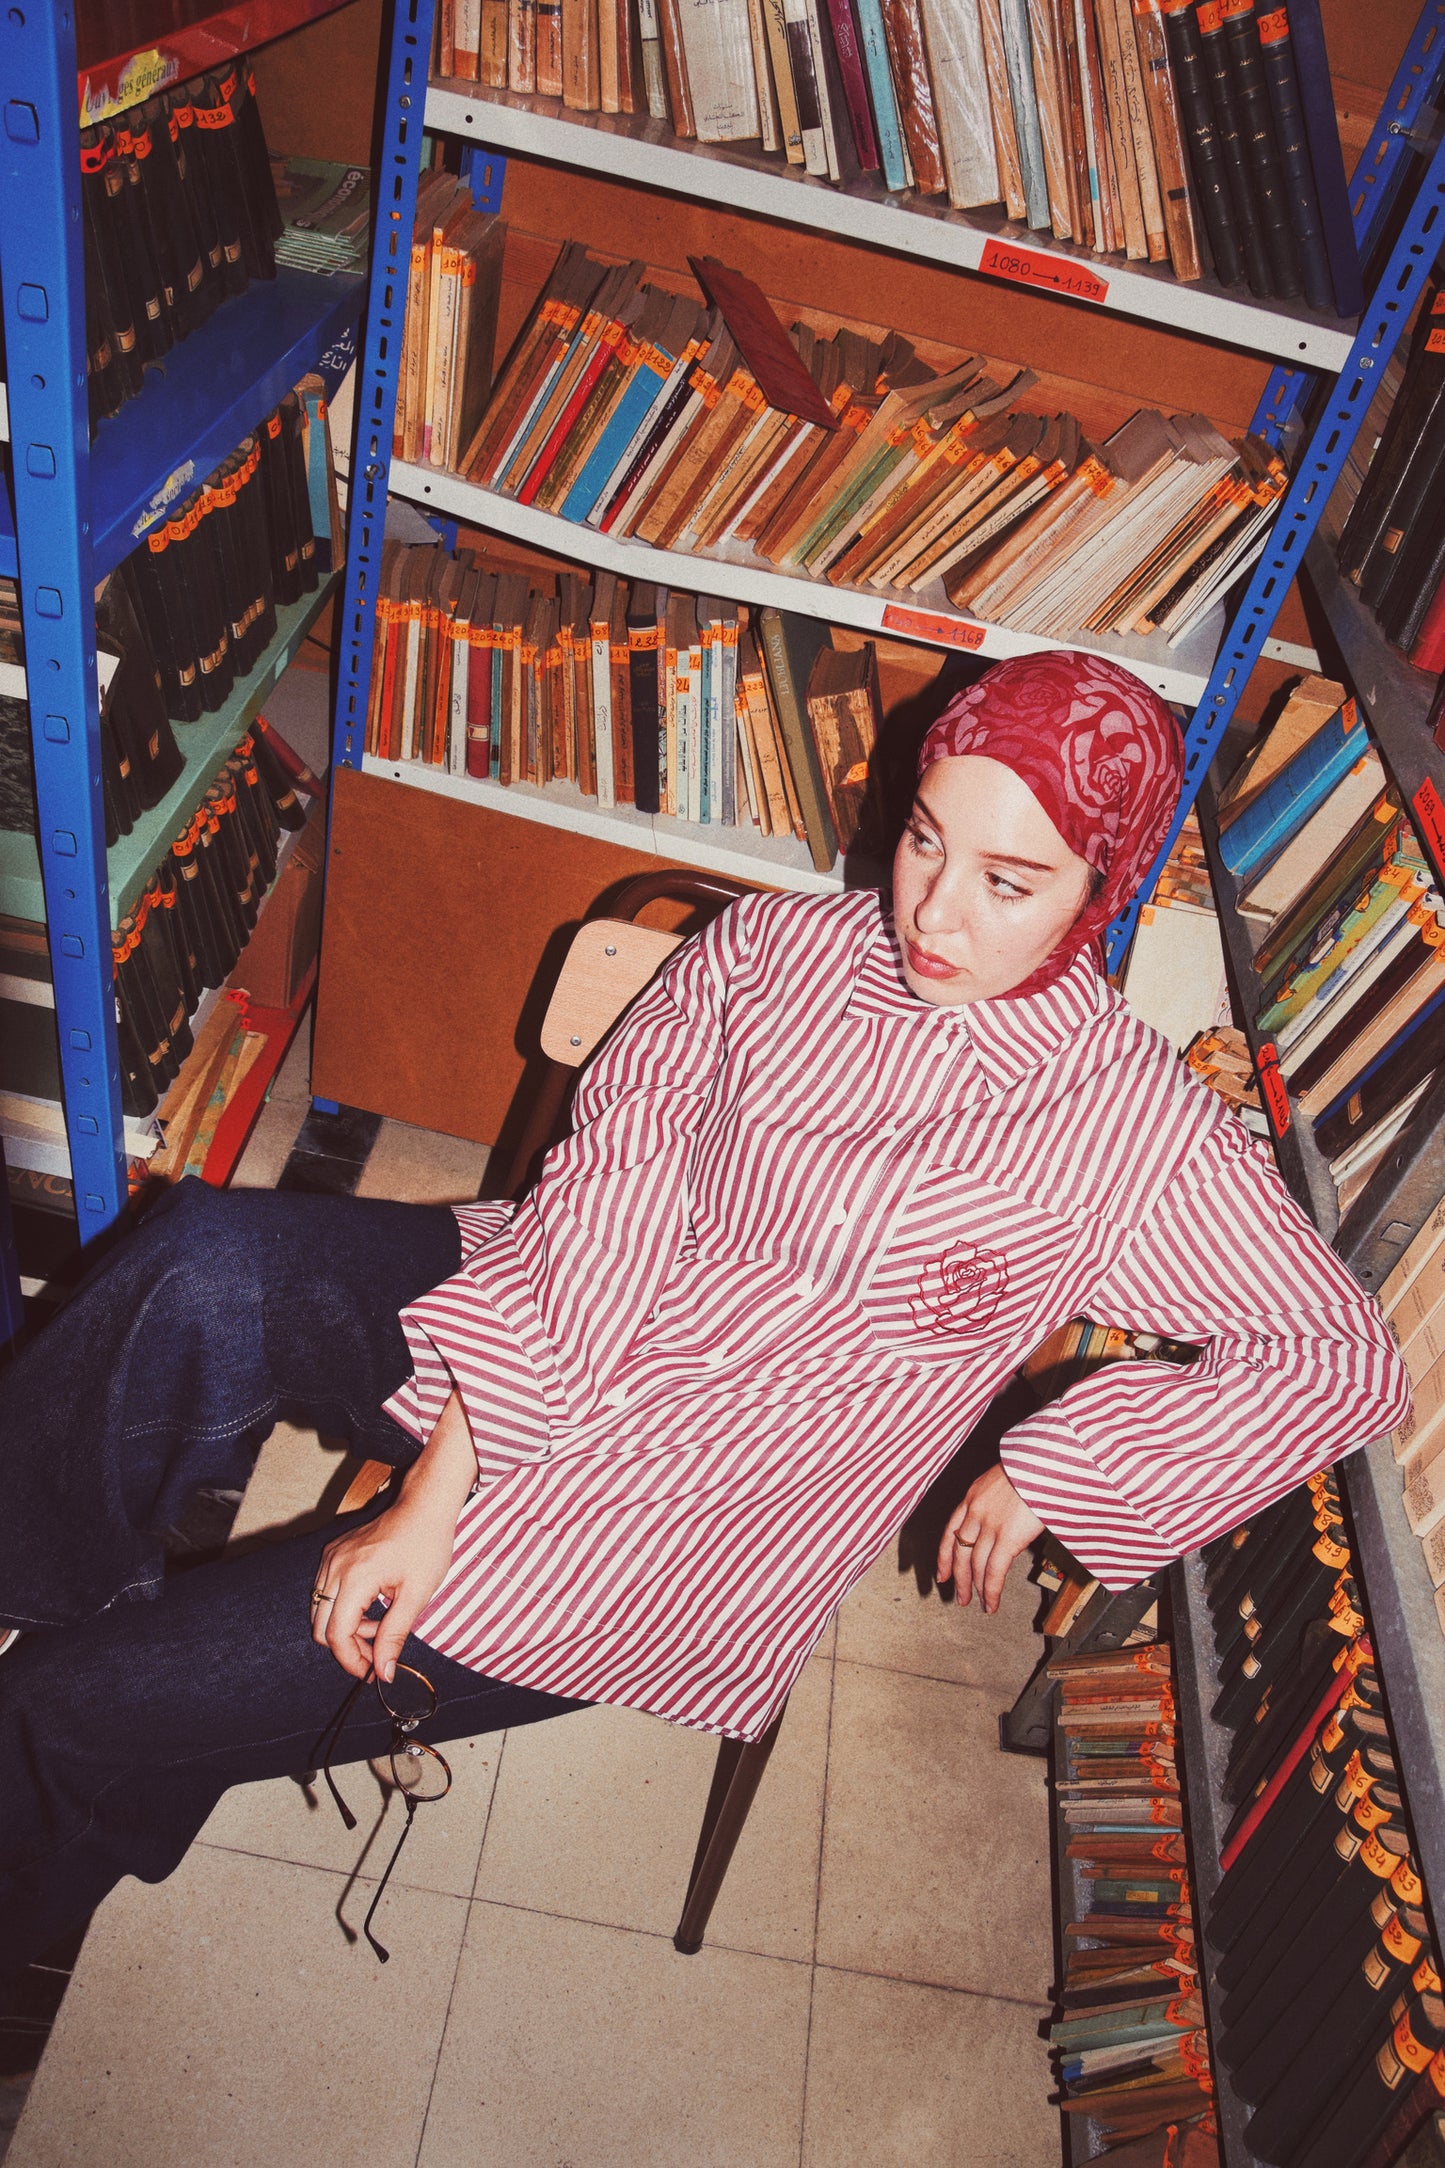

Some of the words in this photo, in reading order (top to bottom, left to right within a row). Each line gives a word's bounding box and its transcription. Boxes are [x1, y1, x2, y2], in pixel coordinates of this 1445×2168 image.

[988, 252, 1031, 276] 1080
[1061, 276, 1100, 296] 1139
[1364, 1836, 1386, 1869] 334
